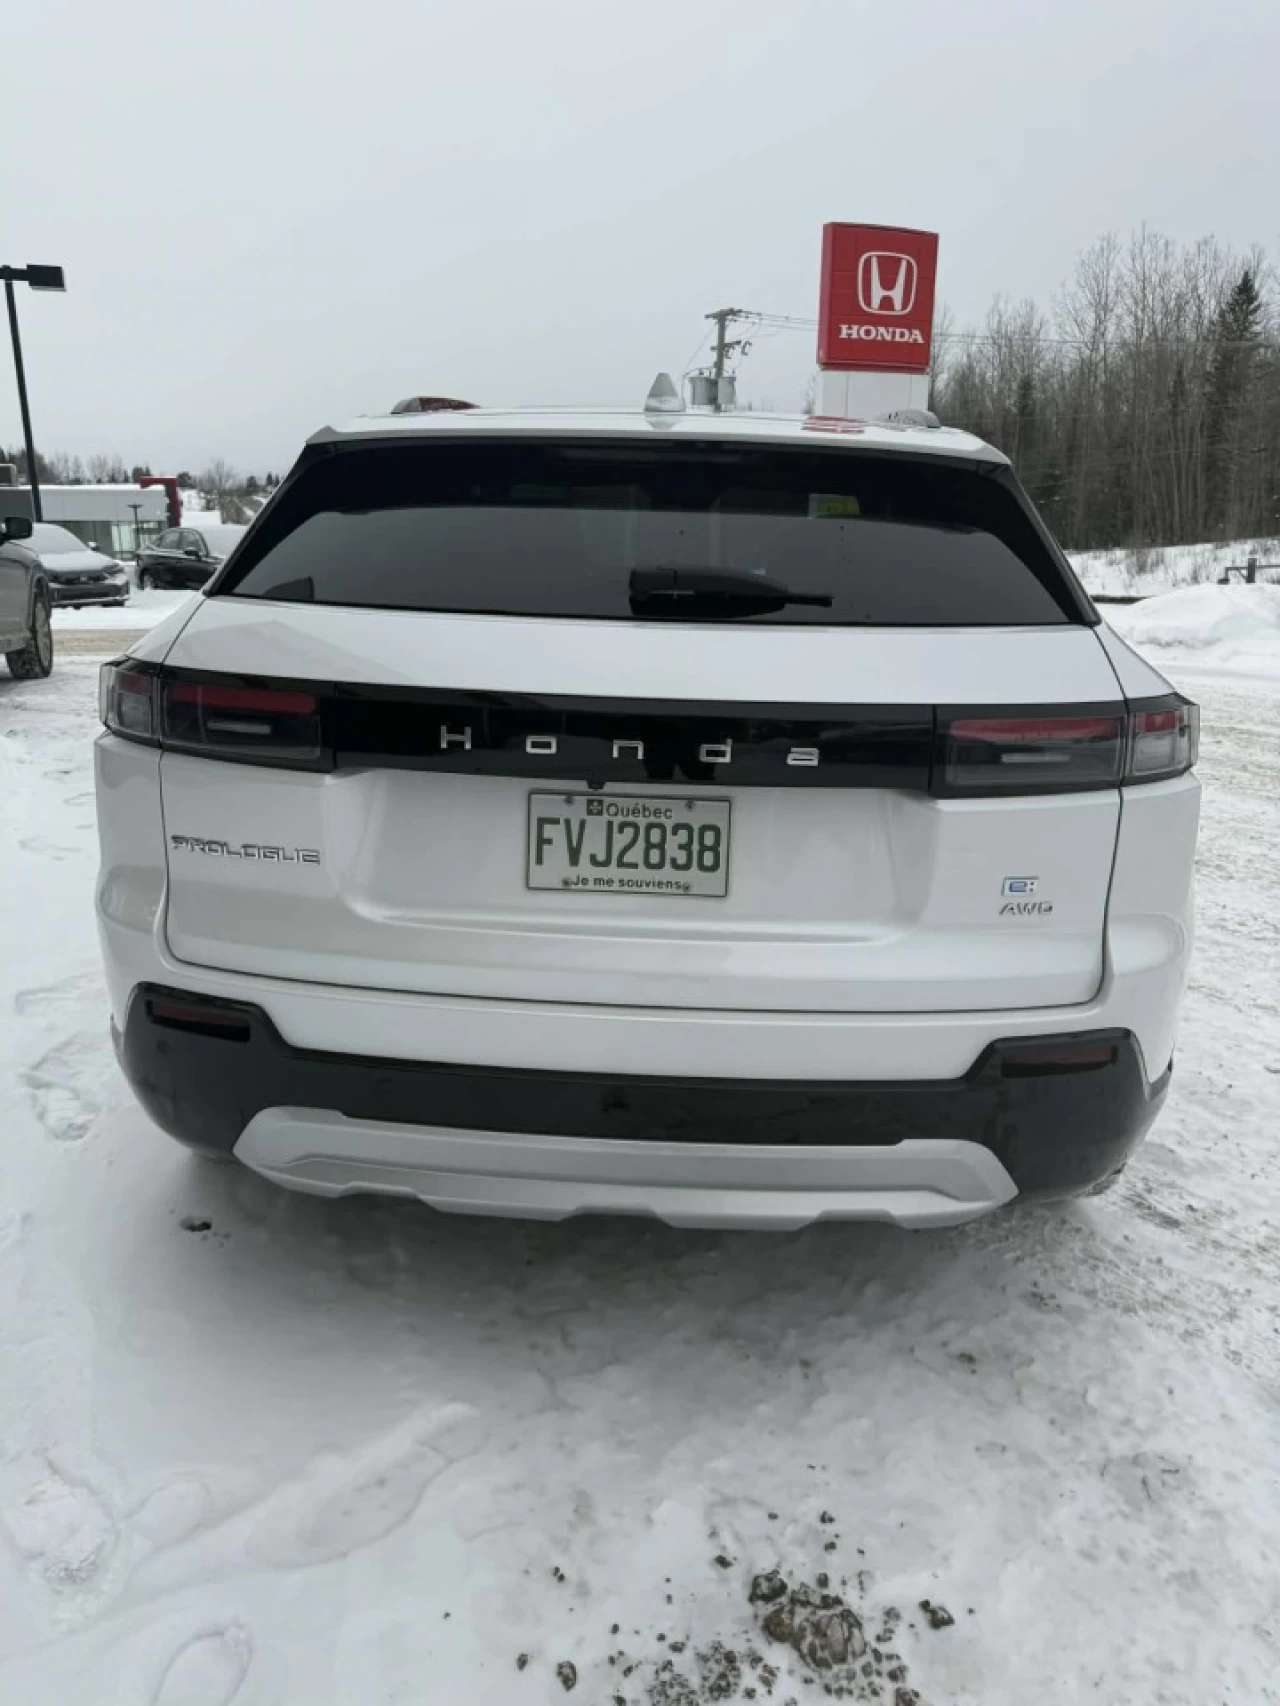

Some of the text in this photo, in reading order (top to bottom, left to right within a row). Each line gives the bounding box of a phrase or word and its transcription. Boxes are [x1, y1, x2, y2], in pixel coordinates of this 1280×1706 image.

[839, 325, 924, 343] HONDA
[606, 803, 673, 820] Québec
[171, 835, 320, 865] PROLOGUE
[535, 817, 721, 872] FVJ2838
[572, 875, 682, 890] Je me souviens
[999, 901, 1053, 916] AWD
